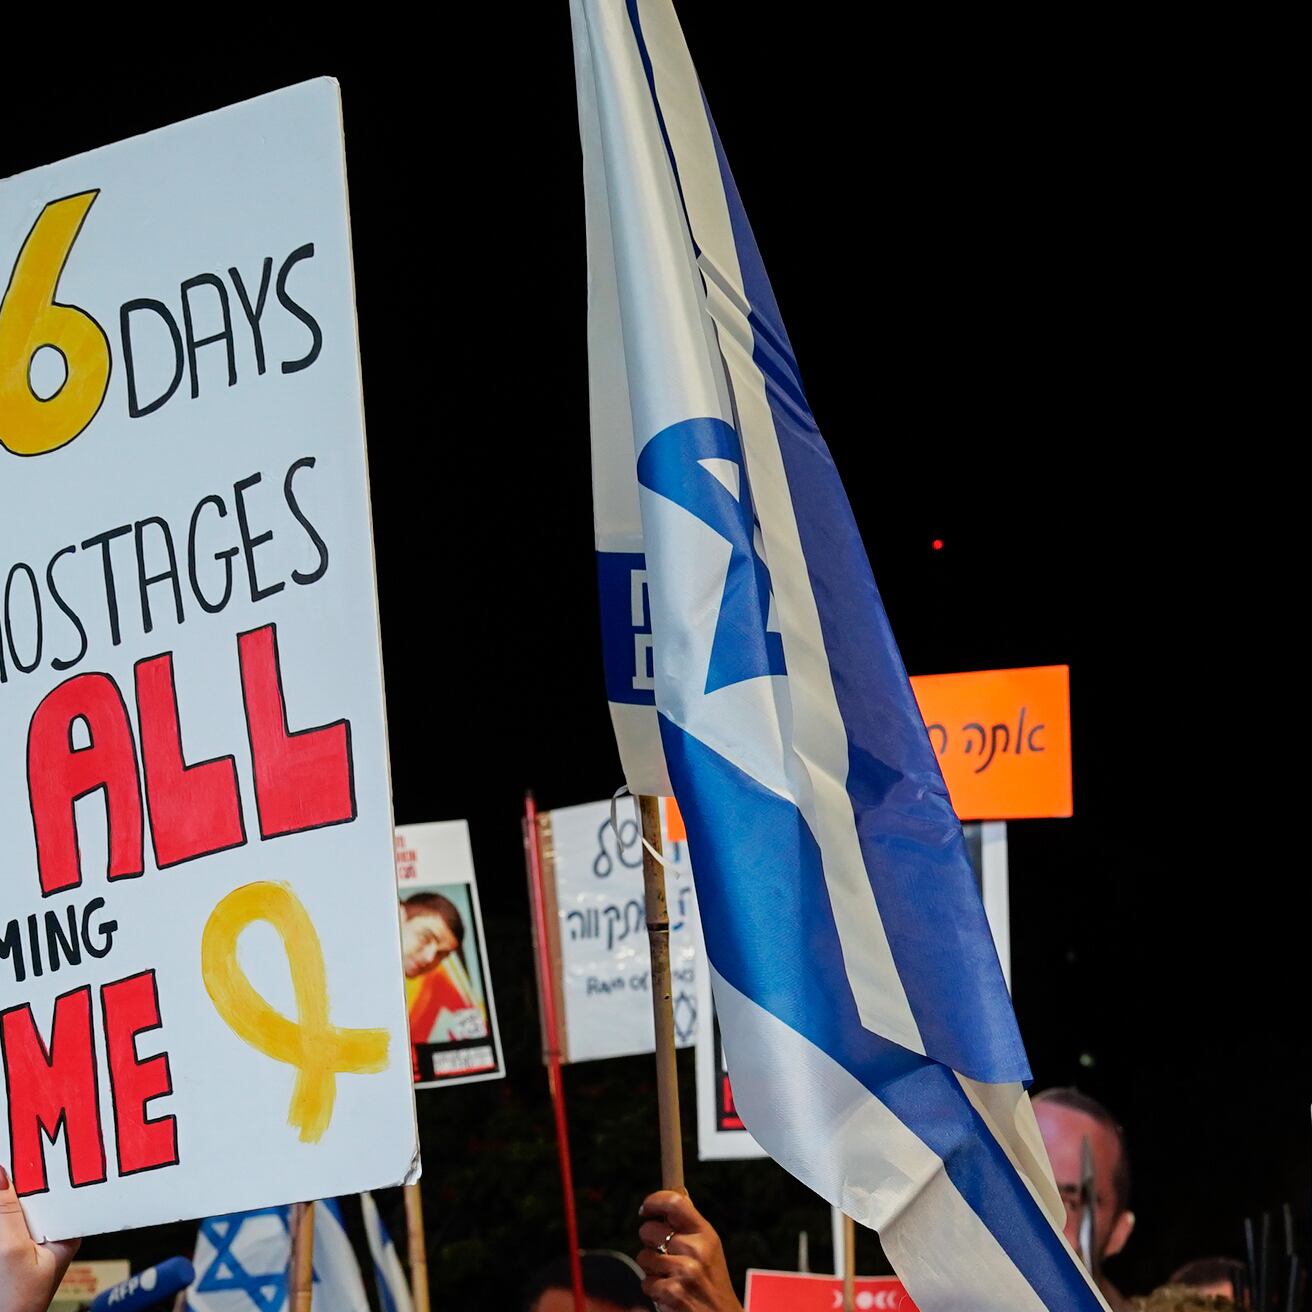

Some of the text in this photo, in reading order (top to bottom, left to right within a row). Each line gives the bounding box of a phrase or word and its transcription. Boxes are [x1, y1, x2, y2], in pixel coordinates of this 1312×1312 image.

[119, 243, 323, 419] DAYS
[26, 622, 357, 898] ALL
[963, 706, 1045, 774] אתה
